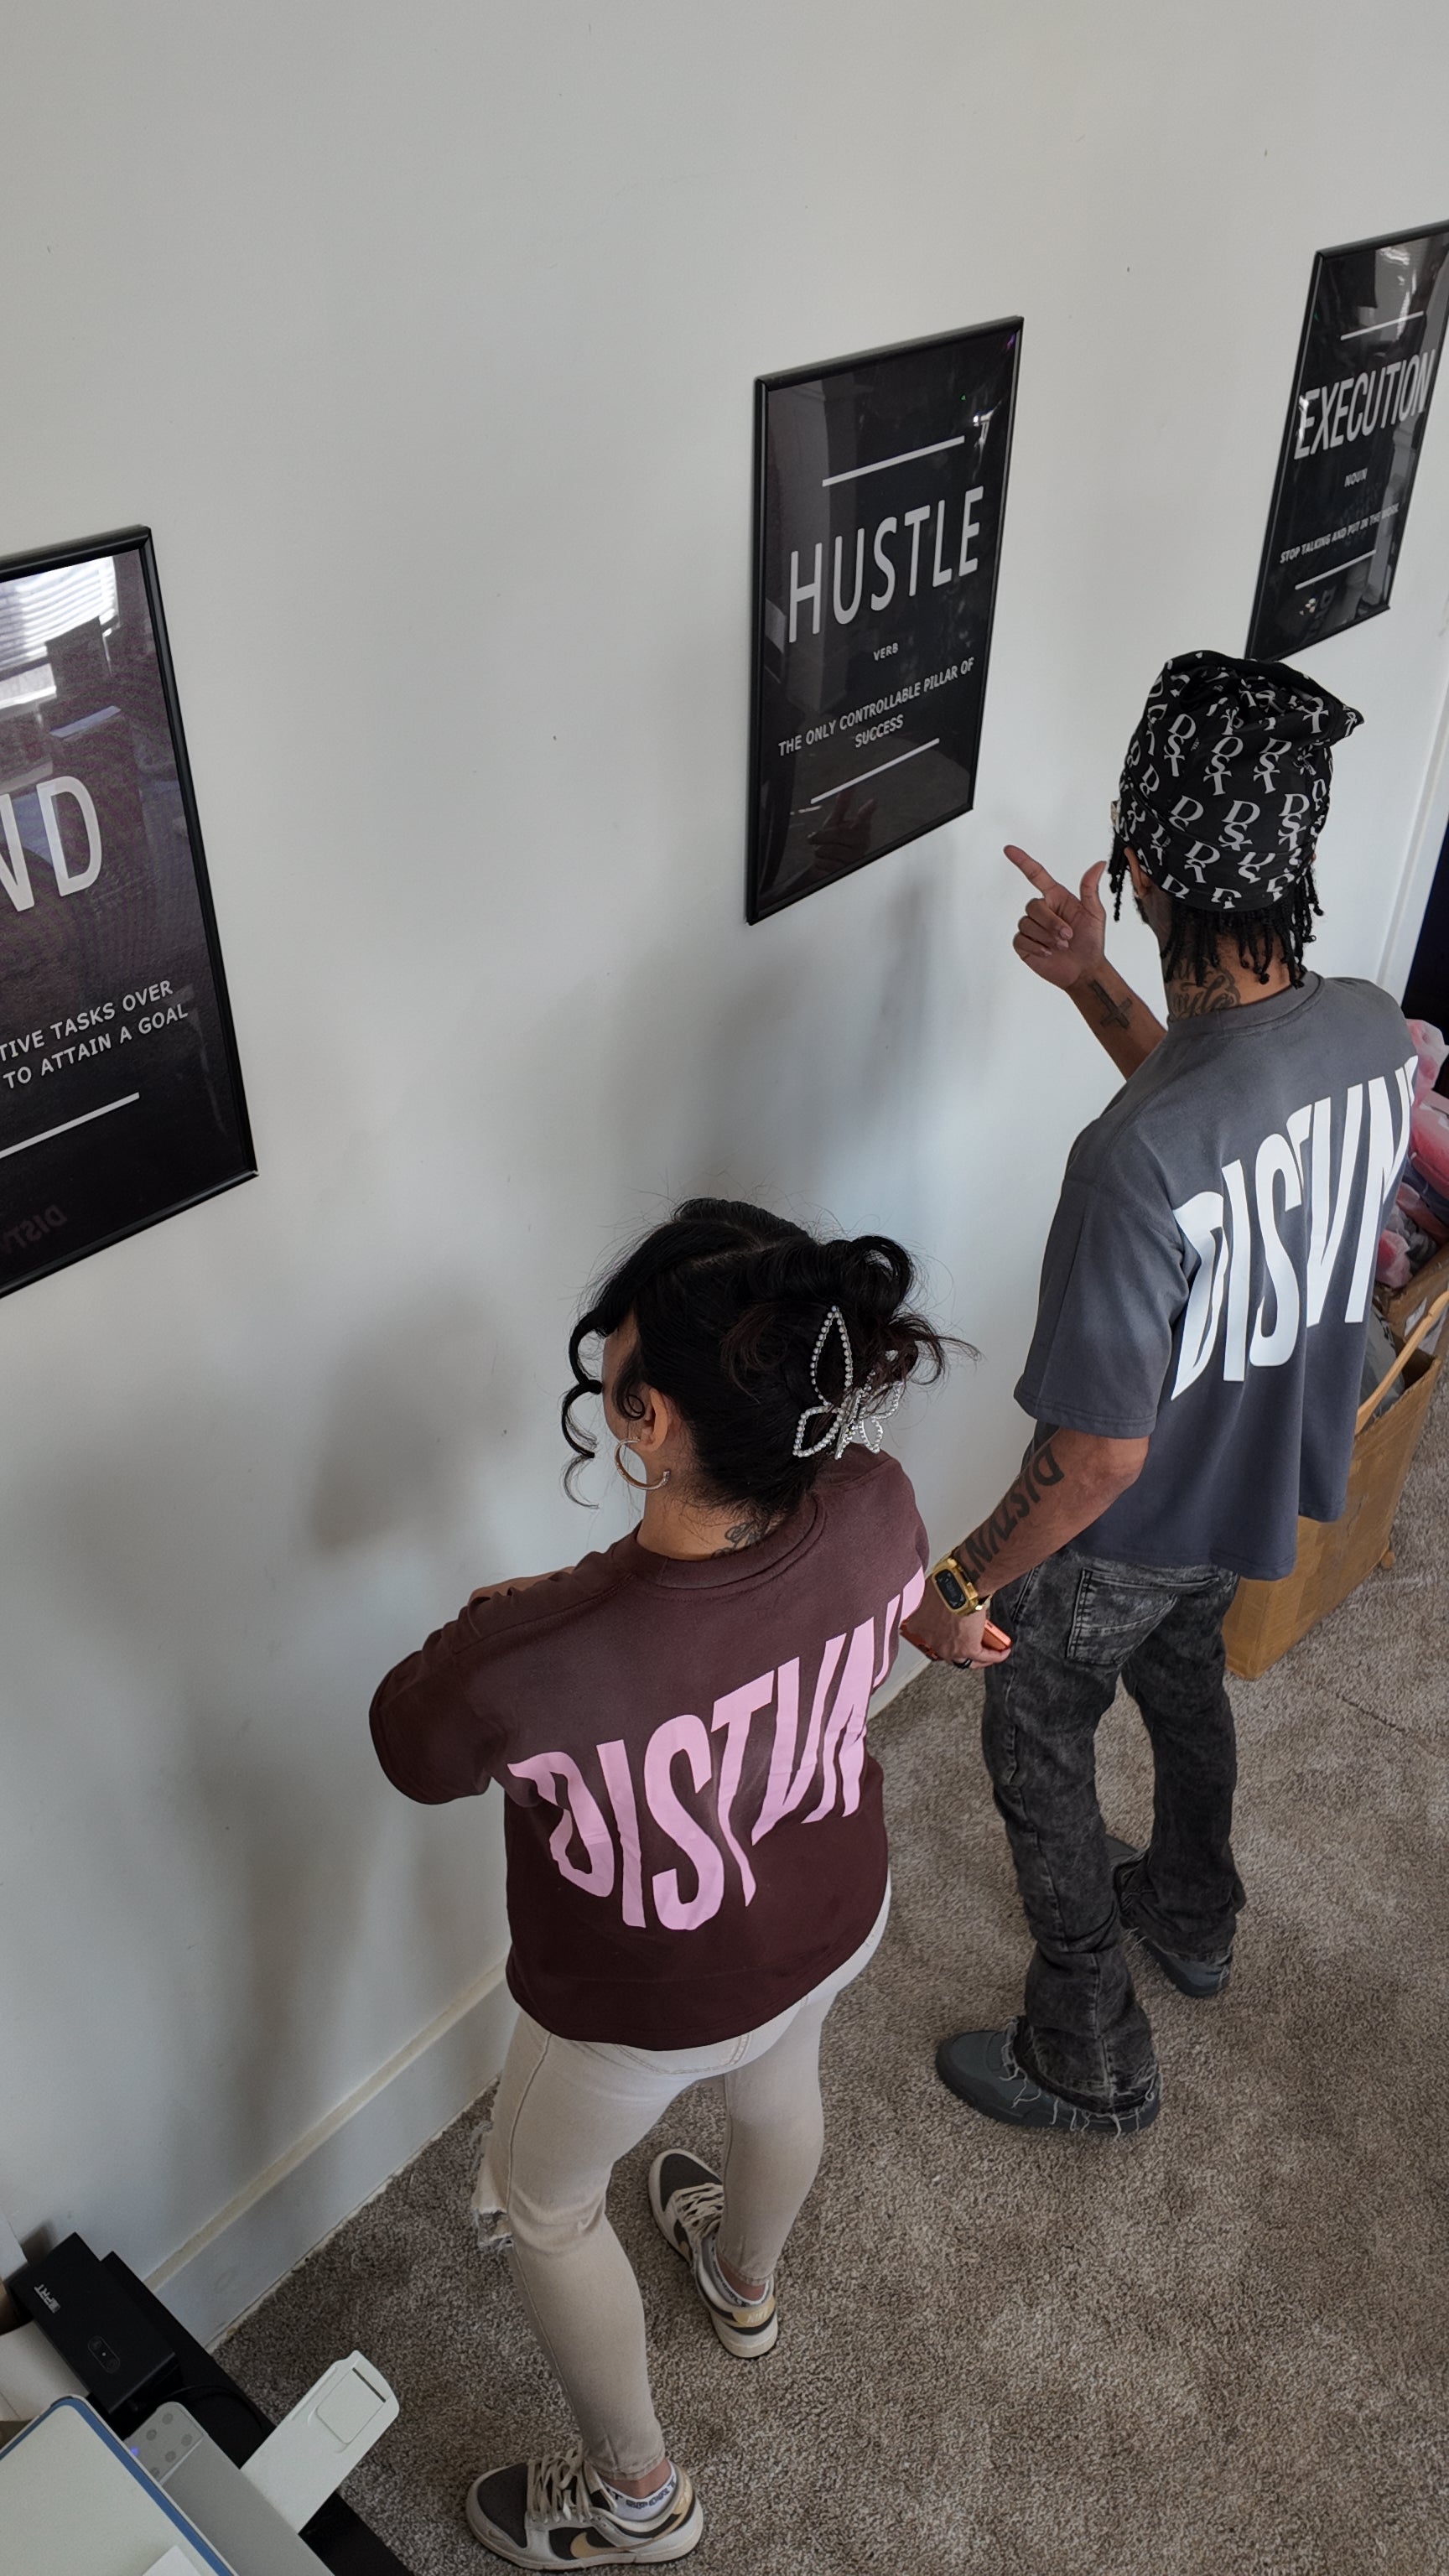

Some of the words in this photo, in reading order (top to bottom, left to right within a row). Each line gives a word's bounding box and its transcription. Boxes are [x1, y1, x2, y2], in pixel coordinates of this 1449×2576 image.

[1294, 349, 1436, 460] EXECUTION
[788, 485, 984, 643] HUSTLE
[1280, 546, 1301, 564] STOP
[1301, 533, 1332, 555] TALKING
[1332, 527, 1348, 543] AND
[1347, 520, 1361, 536] PUT
[873, 641, 900, 662] VERB
[778, 734, 803, 756] THE
[805, 719, 838, 745] ONLY
[839, 682, 922, 730] CONTROLLABLE
[923, 664, 958, 693] PILLAR
[960, 657, 975, 675] OF
[854, 714, 905, 748] SUCCESS
[3, 1067, 32, 1089] TO
[41, 1033, 112, 1076] ATTAIN
[119, 1026, 132, 1044] A
[138, 1004, 189, 1035] GOAL
[49, 1002, 116, 1040] TASKS
[122, 980, 174, 1011] OVER
[1171, 1055, 1418, 1400] DISVN
[507, 1566, 925, 1930] DISTVN
